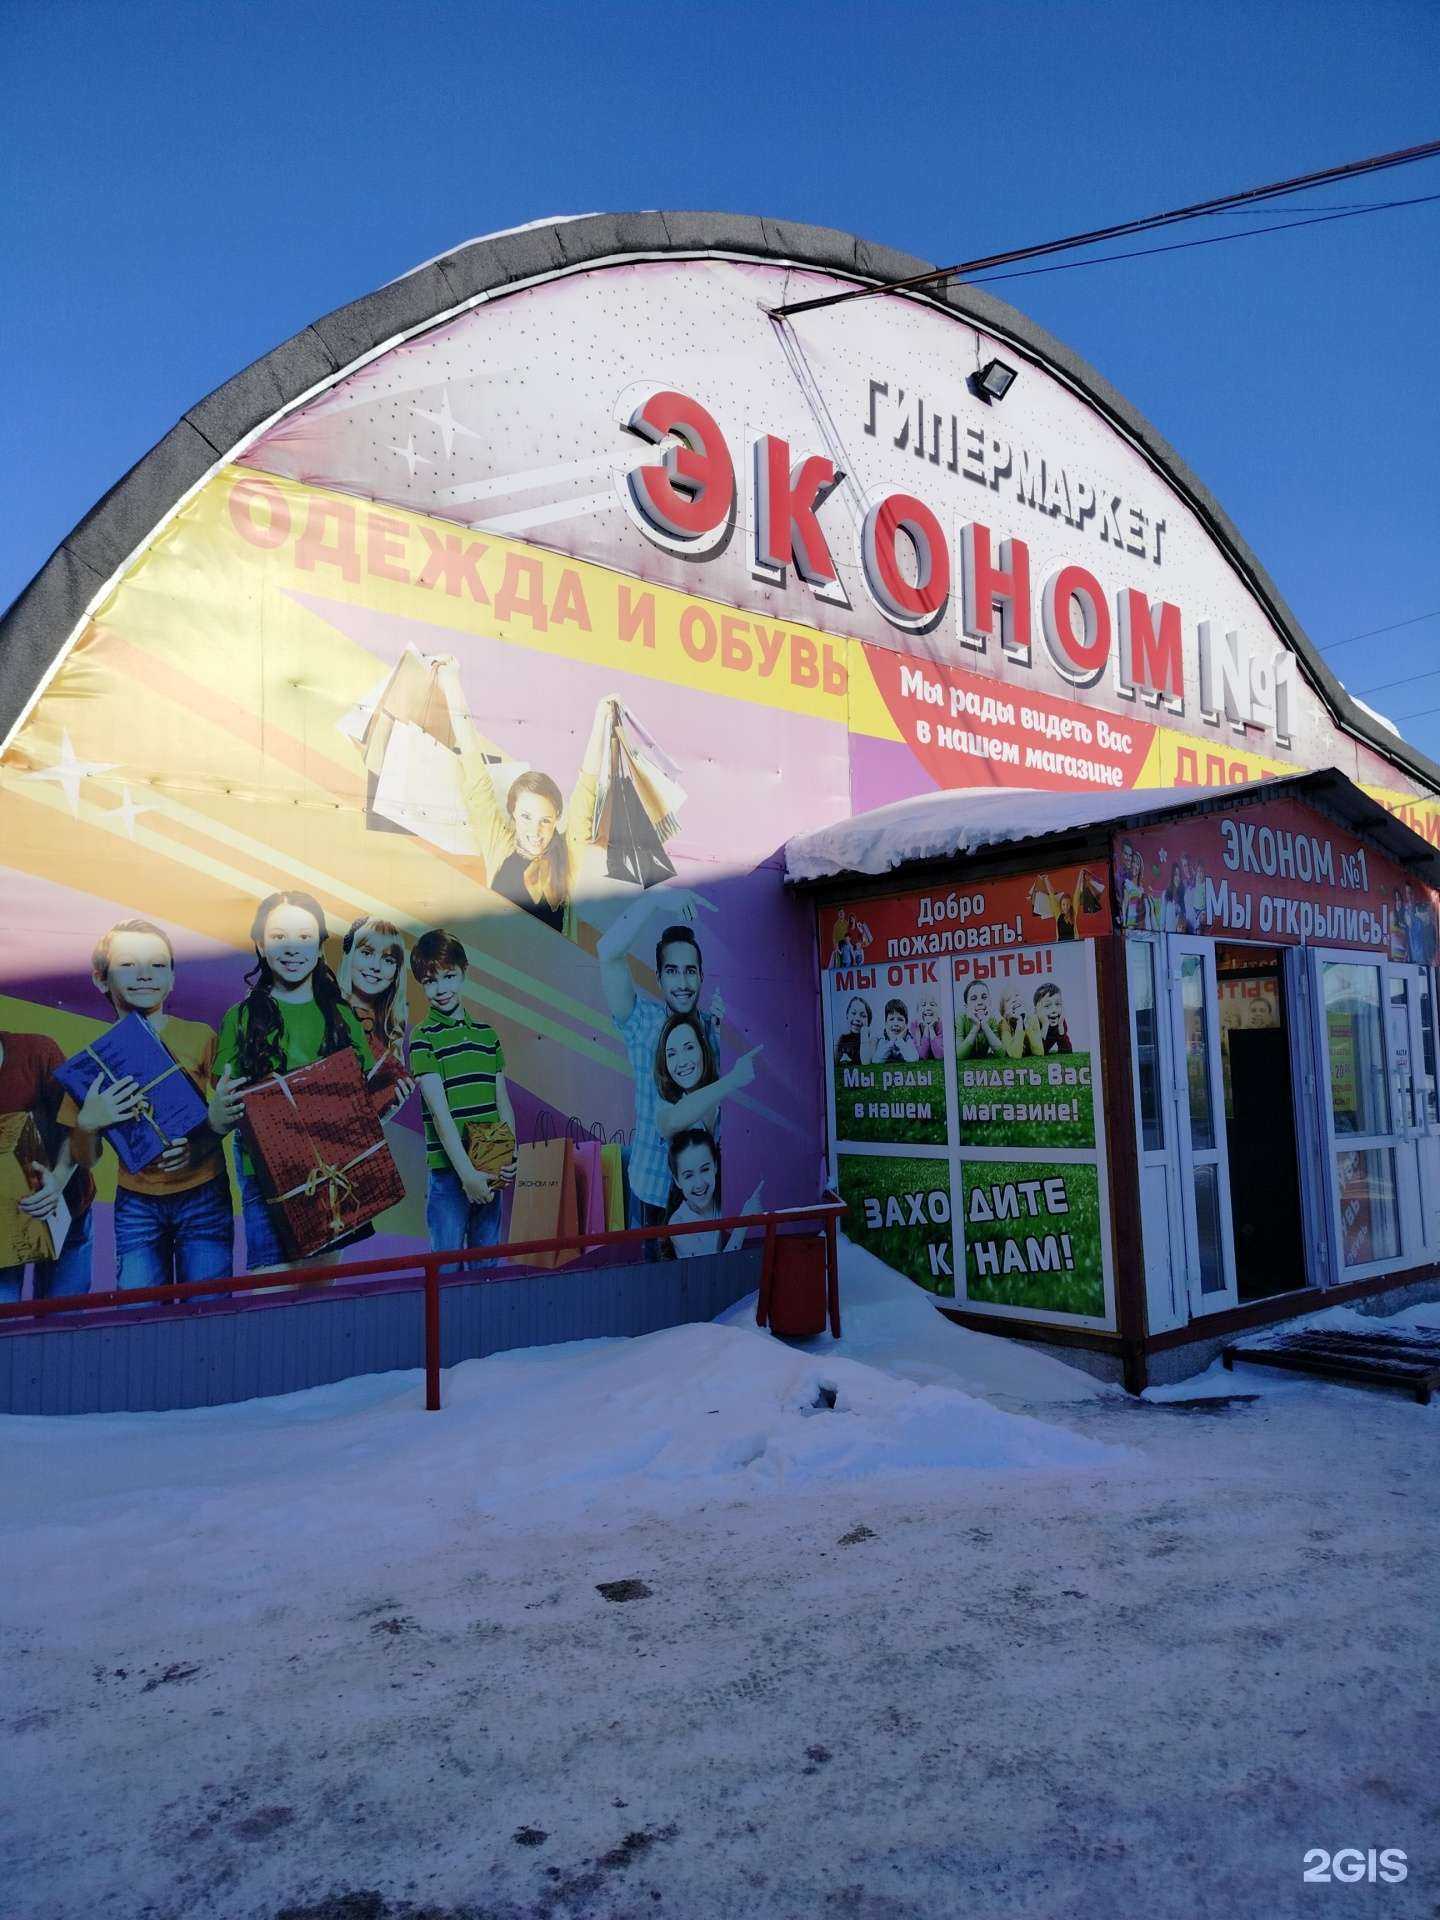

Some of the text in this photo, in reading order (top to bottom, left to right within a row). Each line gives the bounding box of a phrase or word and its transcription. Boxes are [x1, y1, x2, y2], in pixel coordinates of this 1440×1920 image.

[864, 379, 1167, 565] ГИПЕРМАРКЕТ
[228, 477, 850, 696] ОДЕЖДА И ОБУВЬ
[625, 391, 1297, 742] ЭКОНОМ №1
[900, 665, 1133, 754] Мы рады видеть Вас
[916, 720, 1124, 787] в нашем магазине
[1220, 819, 1369, 892] ЭКОНОМ №1
[887, 915, 1023, 958] пожаловать!
[917, 894, 985, 928] Добро
[1205, 877, 1389, 946] Мы открылись!
[835, 968, 877, 992] МЫ
[844, 1063, 1092, 1091] Мы рады видеть Вас
[854, 1099, 1079, 1121] в нашем магазине!
[928, 1234, 1075, 1276] К НАМ!
